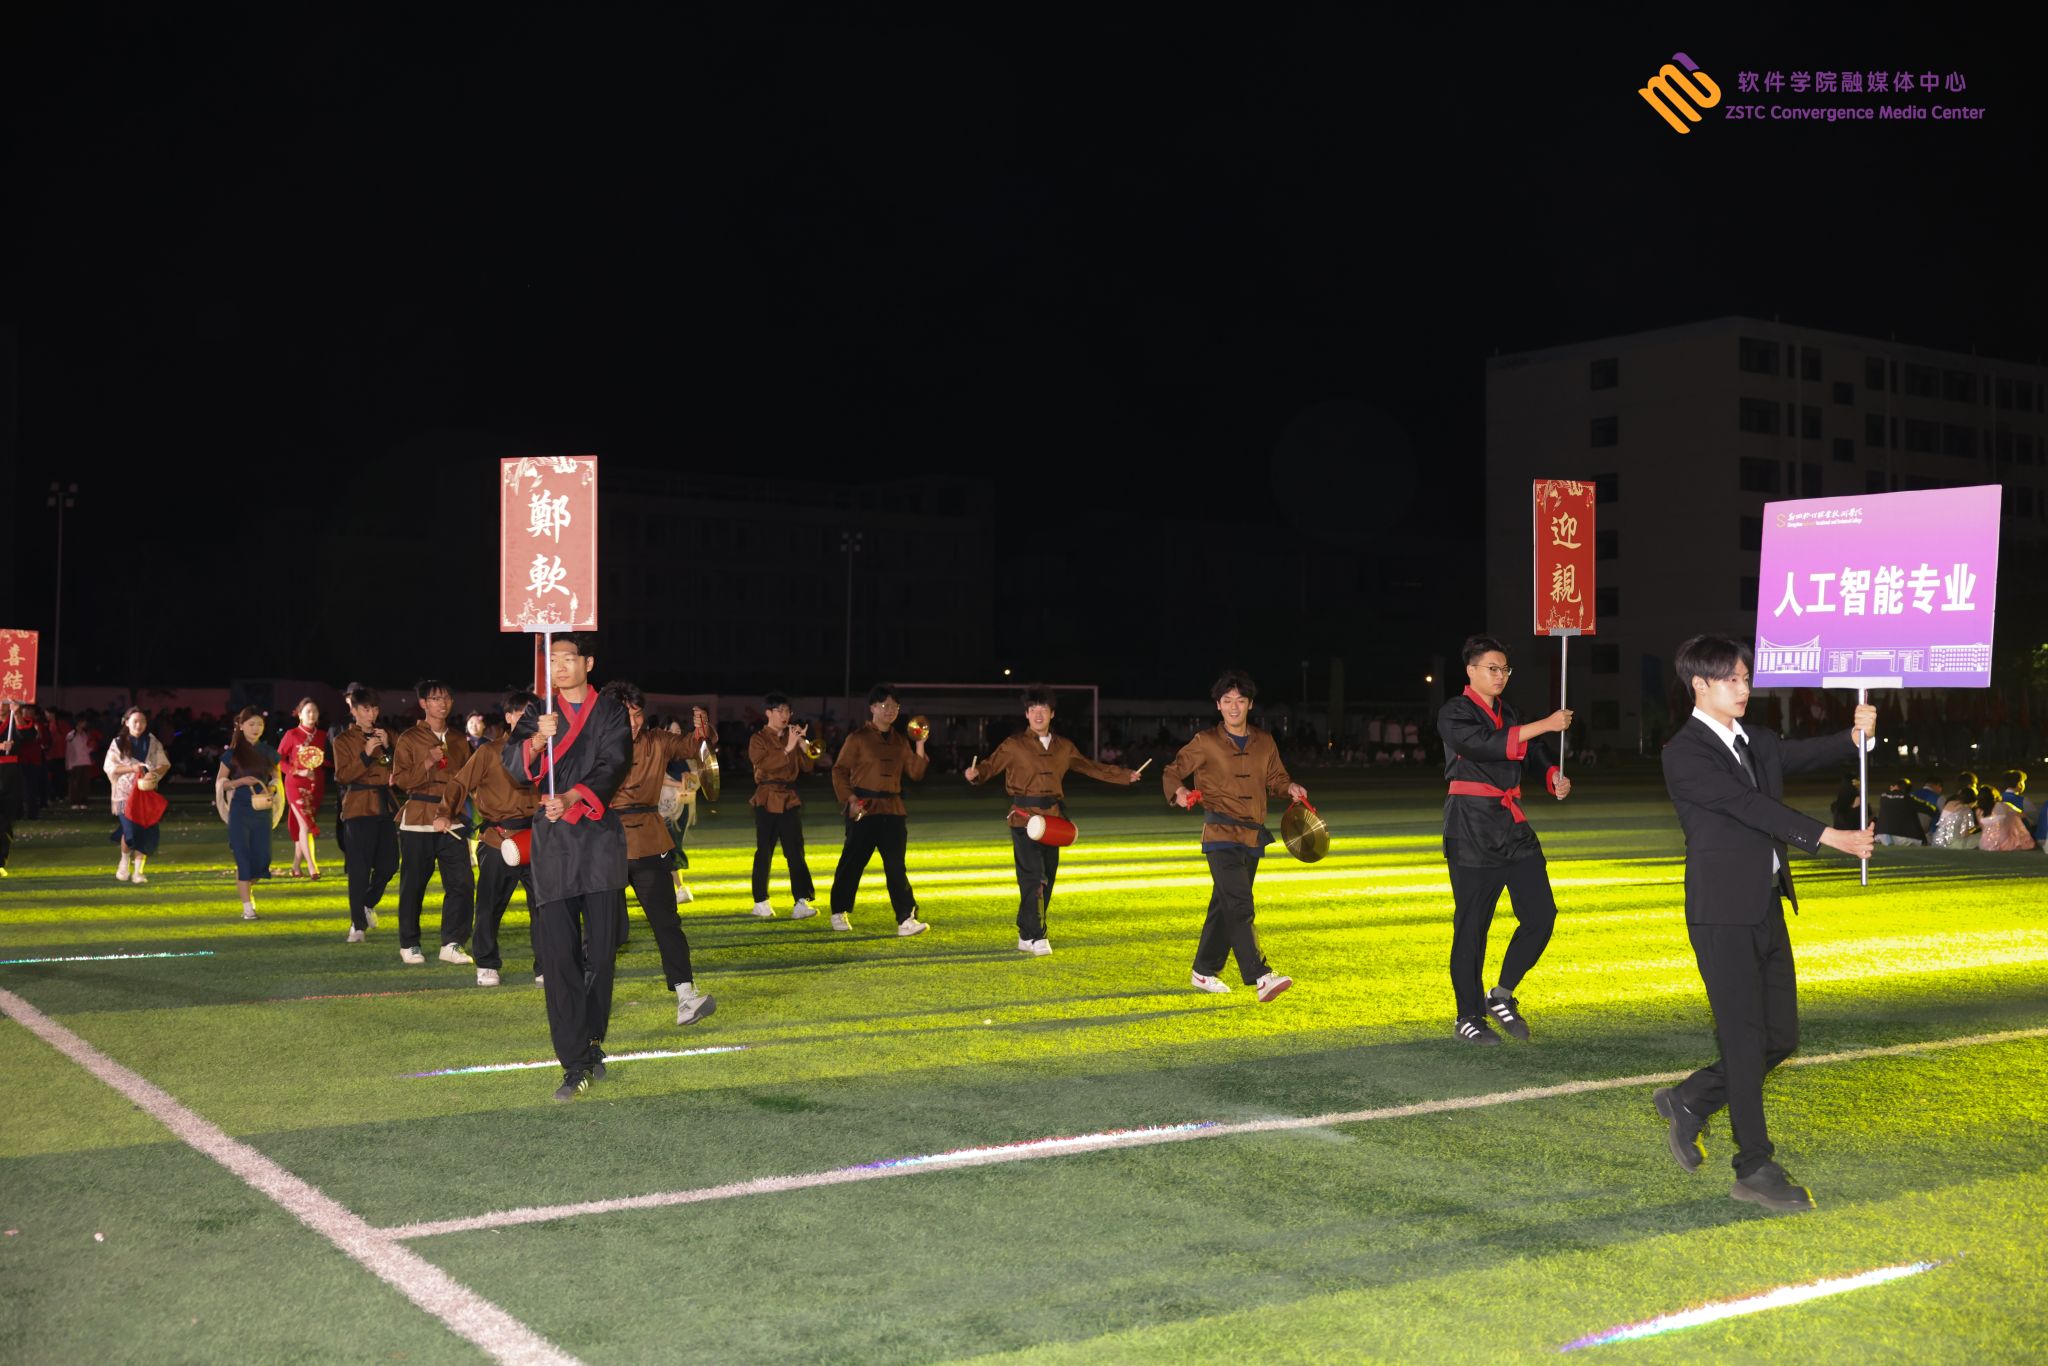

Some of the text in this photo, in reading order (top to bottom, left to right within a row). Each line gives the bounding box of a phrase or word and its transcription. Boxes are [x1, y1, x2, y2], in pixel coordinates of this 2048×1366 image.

[525, 489, 572, 599] 鄭軟
[1550, 511, 1582, 604] 迎親
[1773, 562, 1977, 617] 人工智能专业
